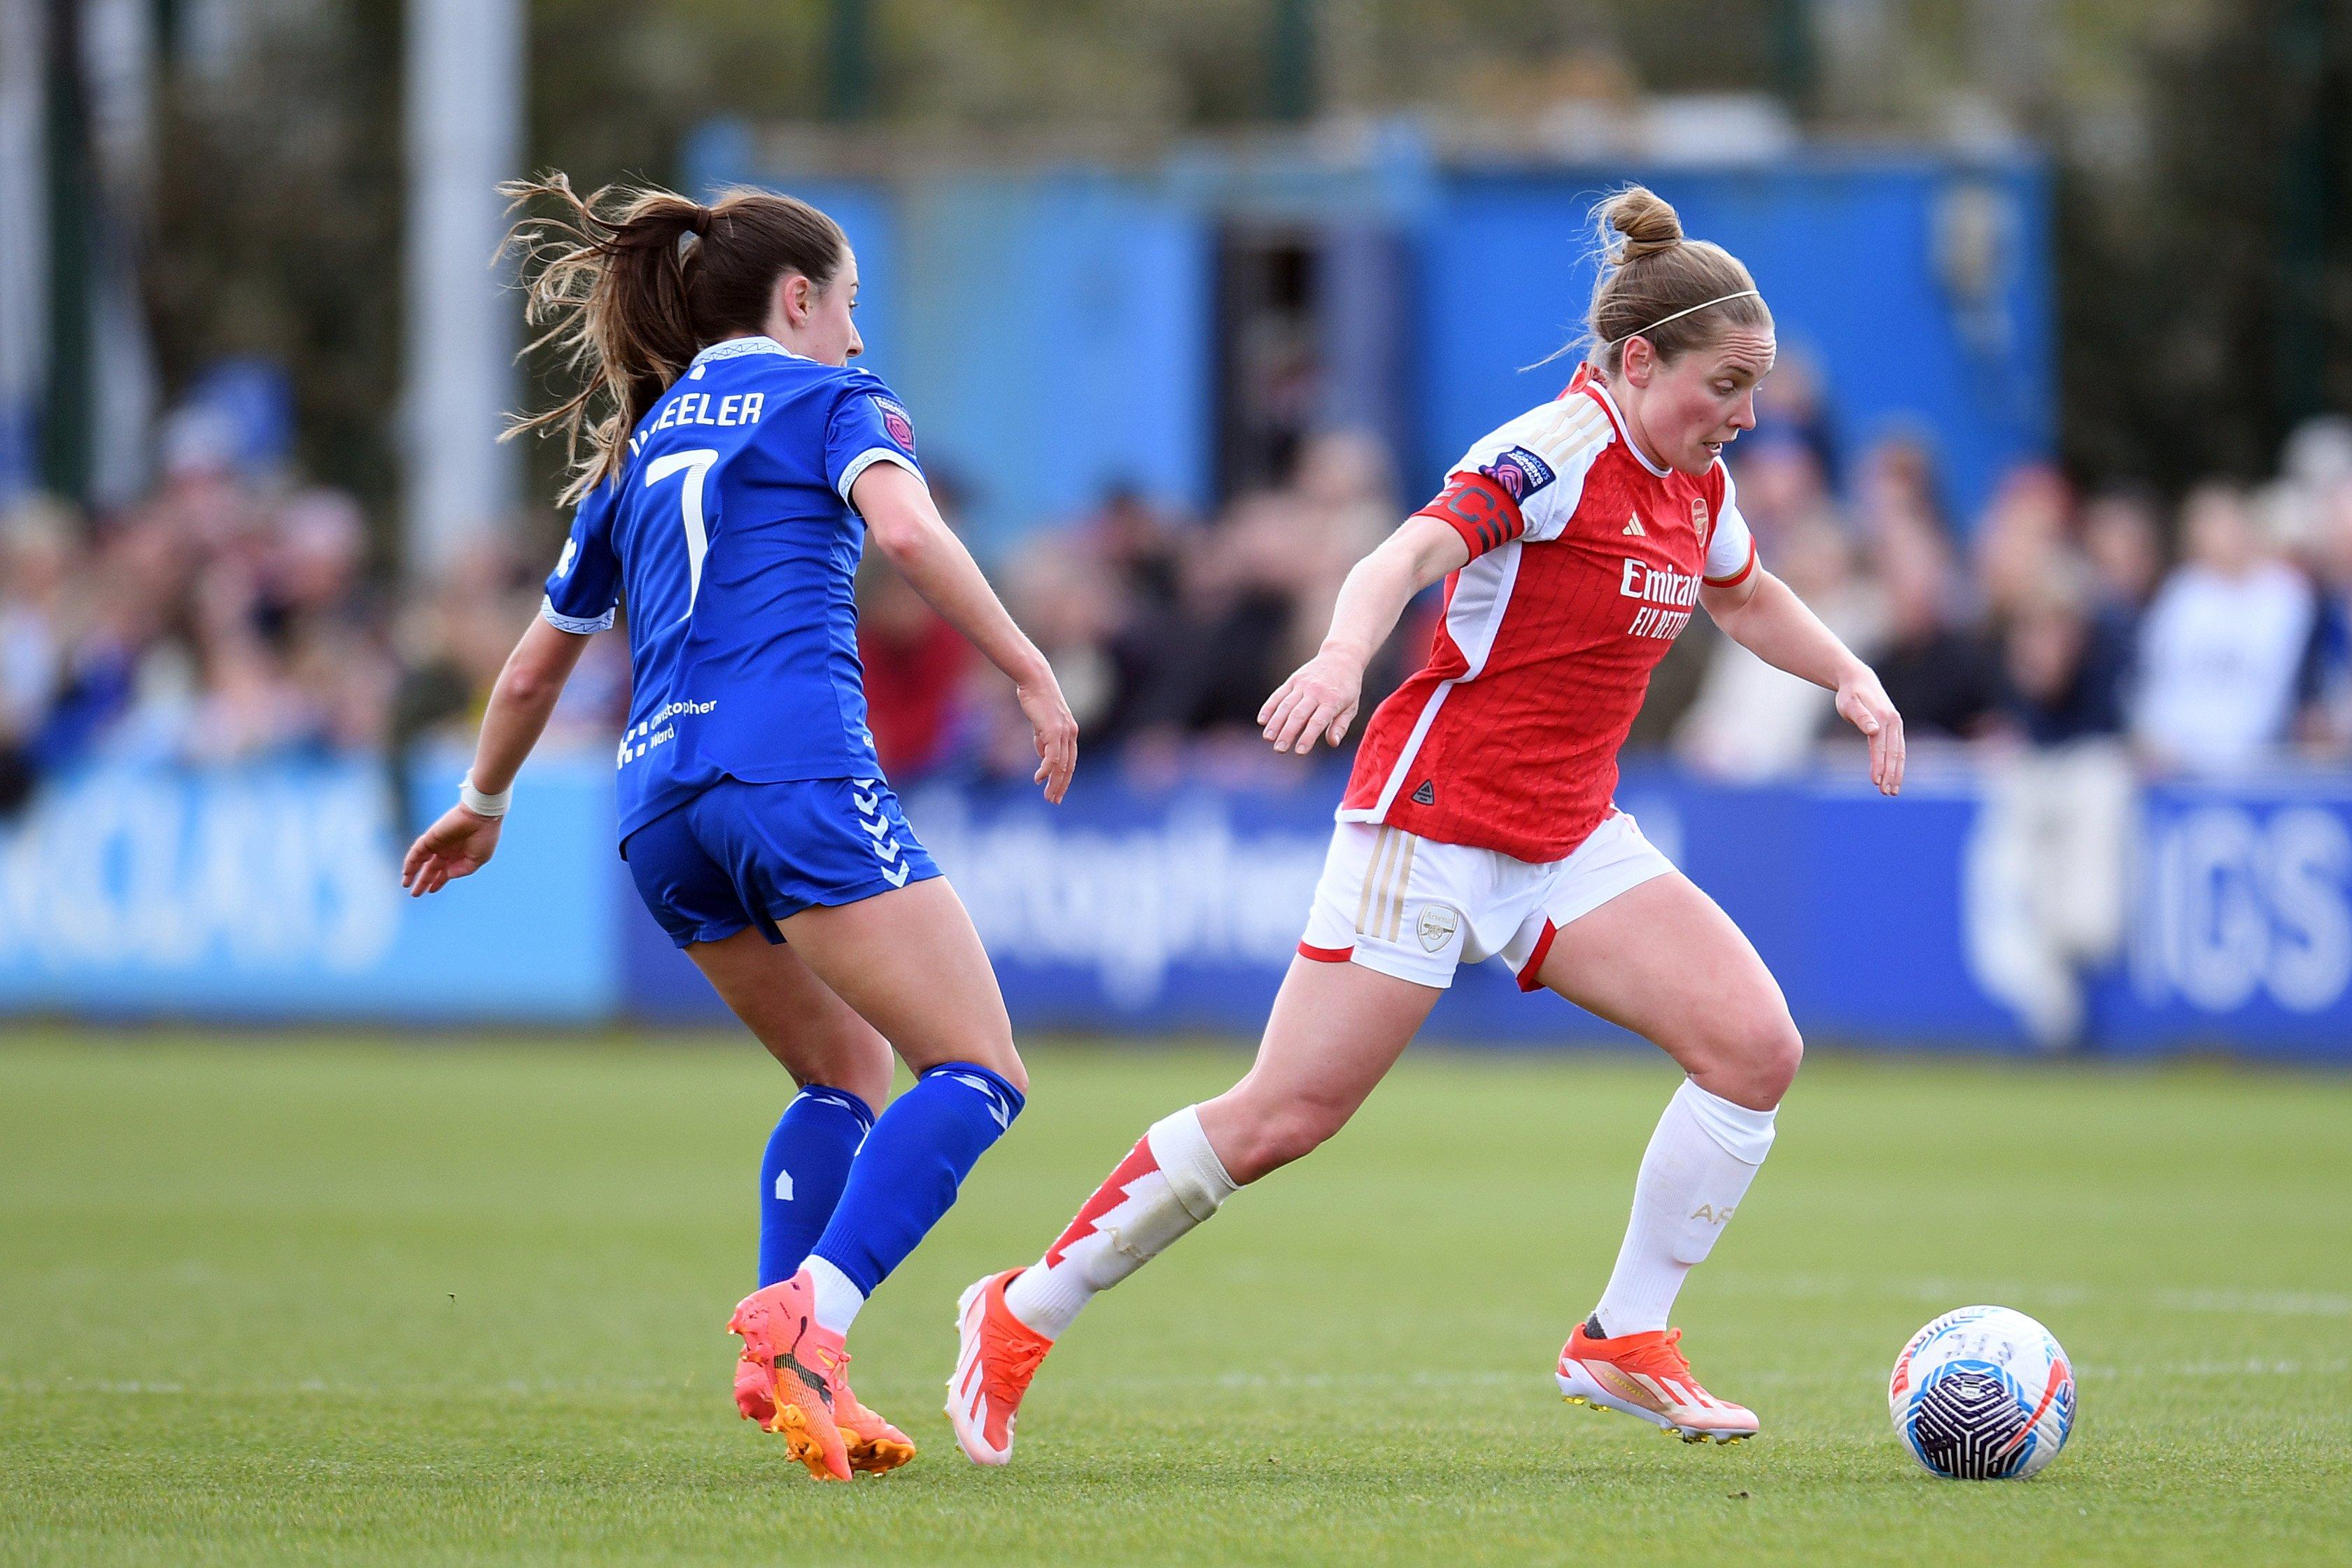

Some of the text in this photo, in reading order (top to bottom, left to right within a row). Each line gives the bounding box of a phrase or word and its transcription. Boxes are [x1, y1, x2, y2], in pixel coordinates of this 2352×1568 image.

[628, 393, 765, 458] EELER
[646, 448, 719, 620] 7
[1627, 606, 1692, 640] FLY BETTE
[651, 699, 717, 730] Cstopher
[650, 722, 675, 749] Ward
